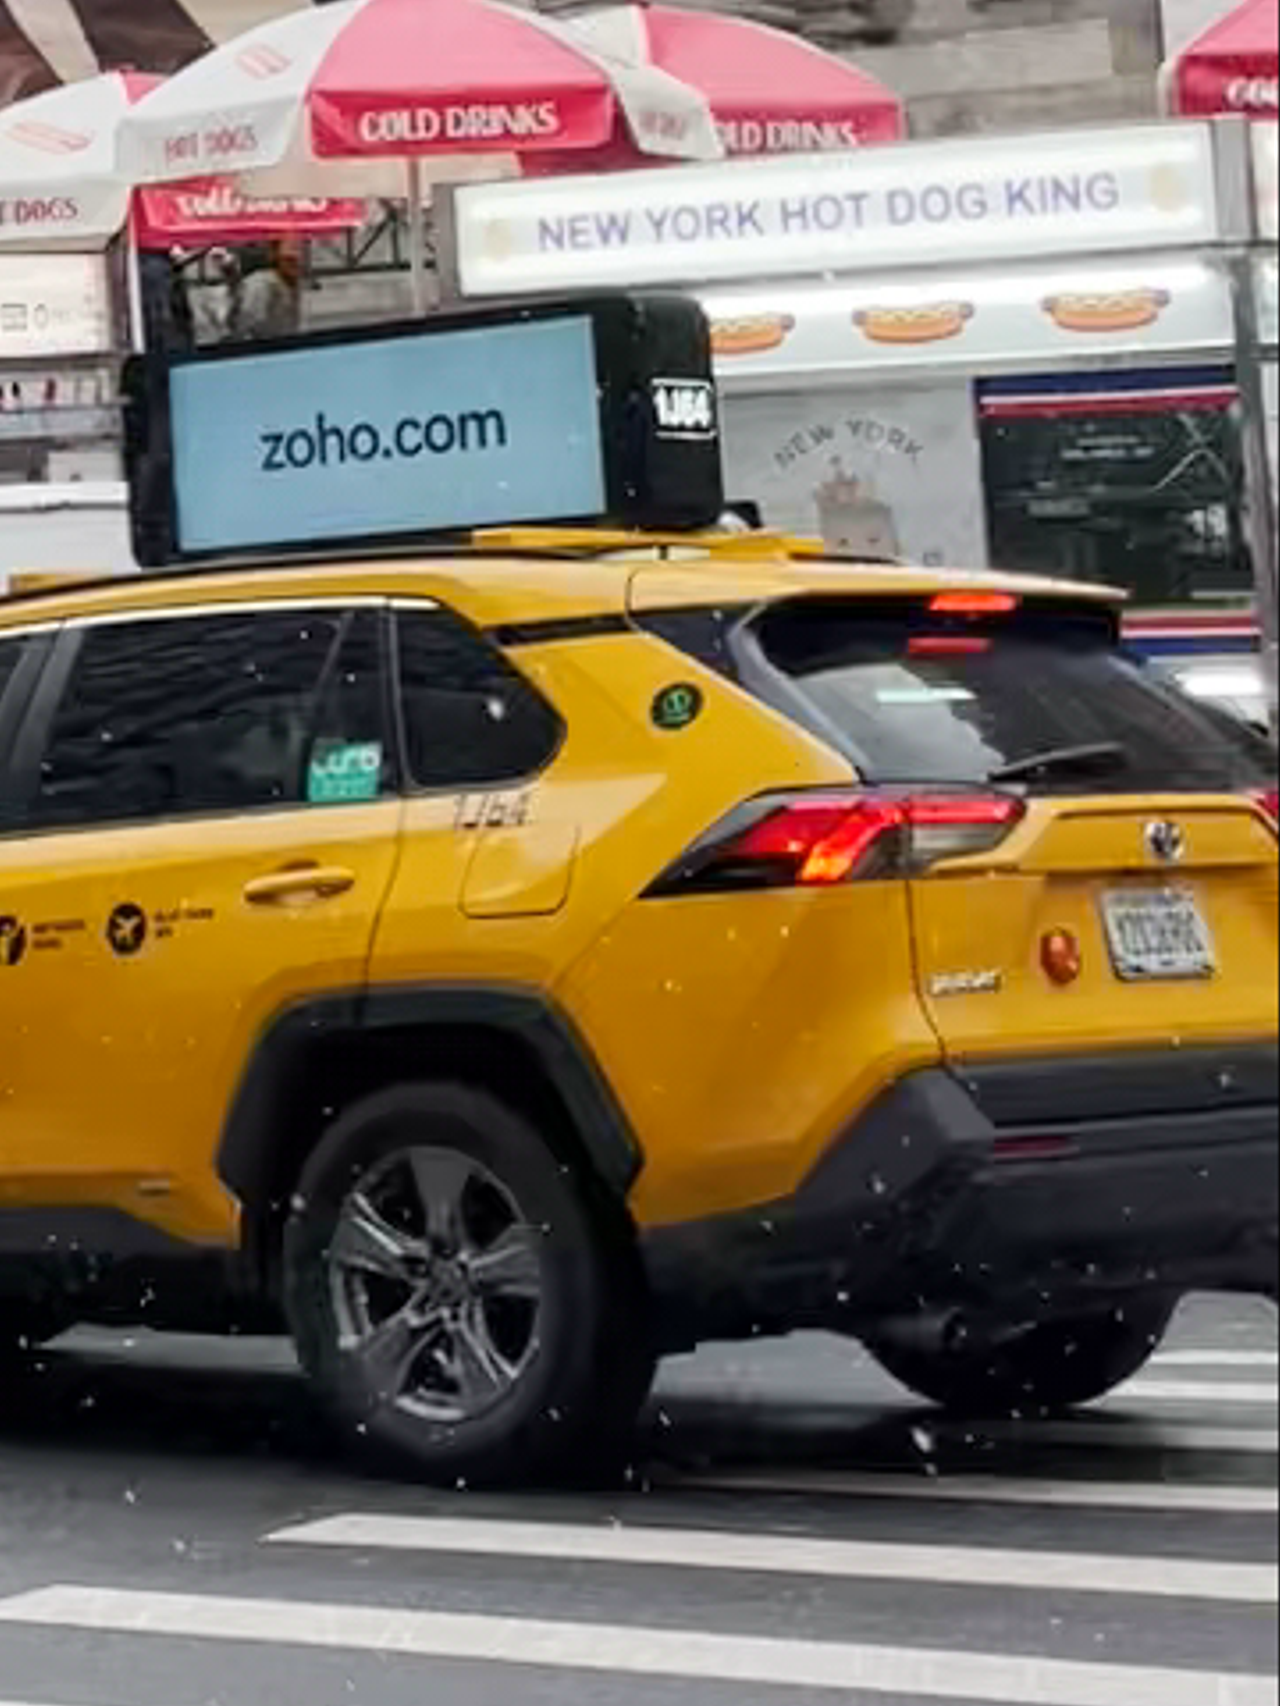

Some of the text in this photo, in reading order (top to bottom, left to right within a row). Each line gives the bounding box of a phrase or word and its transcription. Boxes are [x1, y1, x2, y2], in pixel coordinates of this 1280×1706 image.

[359, 101, 559, 142] COLD DRINKS
[165, 127, 257, 162] HOT DOGS
[15, 198, 78, 226] DOGS
[538, 173, 1120, 252] NEW YORK HOT DOG KING
[259, 409, 507, 471] zoho.com
[774, 419, 924, 468] NEW YORK
